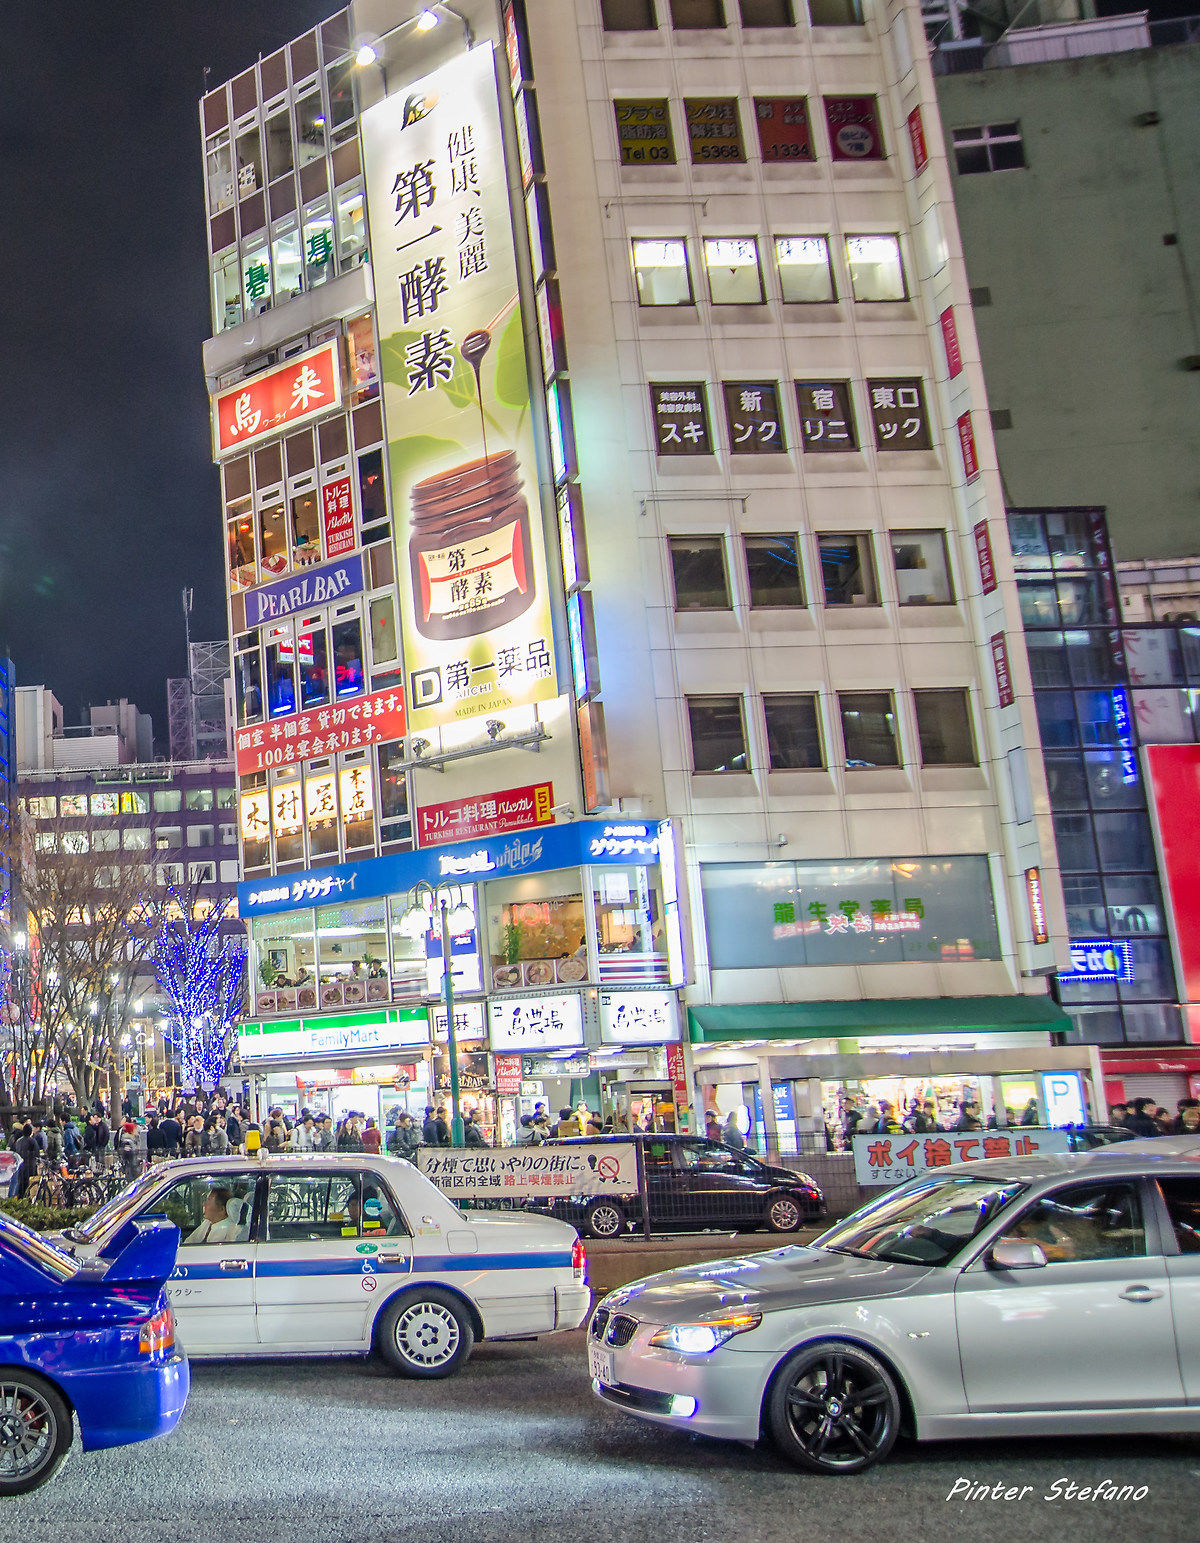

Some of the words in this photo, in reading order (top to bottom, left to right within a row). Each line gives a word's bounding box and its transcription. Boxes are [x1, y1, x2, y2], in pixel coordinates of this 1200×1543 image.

[625, 146, 645, 160] Tel
[650, 146, 670, 159] 03
[307, 227, 333, 268] 碁
[245, 262, 271, 300] 碁
[390, 158, 457, 397] 第一酵素
[740, 390, 762, 412] 新
[812, 389, 834, 411] 宿
[872, 387, 919, 409] 東口
[262, 410, 288, 427] ウーライ
[661, 422, 705, 443] スキ
[734, 420, 778, 442] ンク
[805, 419, 849, 440] リニ
[879, 418, 921, 439] ック
[325, 483, 350, 502] トルコ
[327, 498, 350, 513] 料理
[328, 528, 354, 544] TURKISH
[447, 546, 490, 573] 第一
[312, 568, 352, 602] BAR
[451, 571, 493, 603] 酵素
[445, 638, 551, 692] 第一薬品
[455, 706, 476, 717] MADE
[487, 697, 513, 711] JAPAN
[237, 728, 265, 750] 個室
[269, 717, 312, 742] 半個室
[316, 694, 403, 731] 貸切できます。
[257, 723, 382, 769] 100名宴会承ります。
[422, 799, 498, 831] トルコ料理
[498, 797, 534, 815] パムッカレ
[536, 791, 549, 818] 5F
[424, 829, 455, 842] TURKISH
[455, 820, 498, 837] RESTAURANT
[310, 1028, 380, 1048] FamilyMart
[1051, 1081, 1070, 1103] P
[867, 1135, 1040, 1168] ポイ捨て禁止
[425, 1154, 586, 1175] 分煙で思いやりの街に。
[503, 1173, 577, 1187] 路上喫煙禁止
